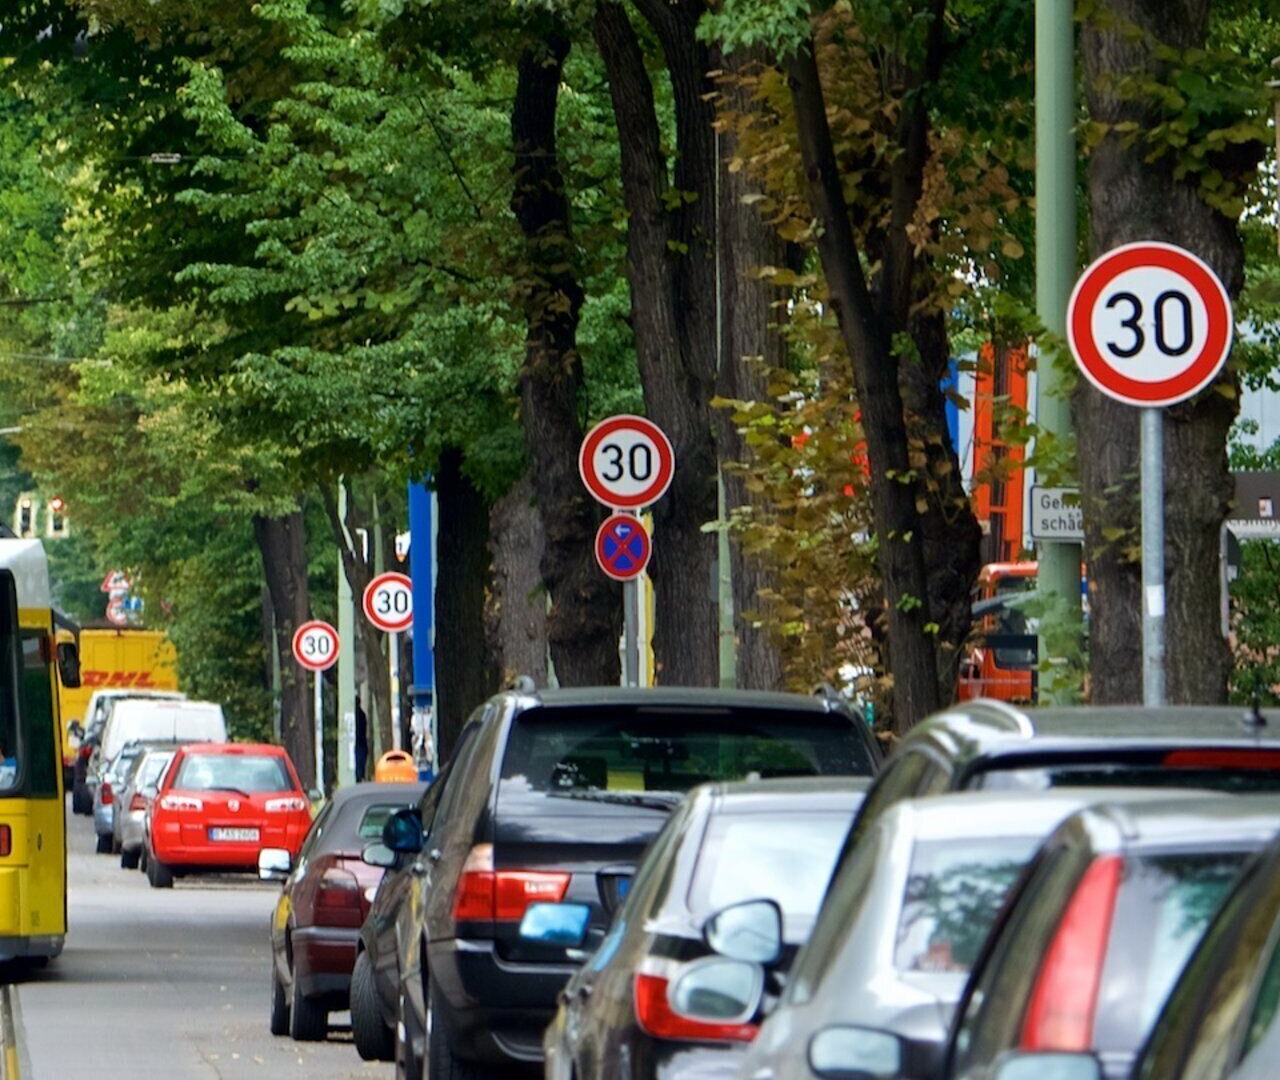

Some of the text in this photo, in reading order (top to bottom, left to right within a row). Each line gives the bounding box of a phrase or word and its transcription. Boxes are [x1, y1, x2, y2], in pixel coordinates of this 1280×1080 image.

[1105, 290, 1194, 358] 30
[602, 443, 652, 482] 30
[377, 589, 408, 614] 30
[305, 635, 330, 655] 30
[83, 671, 154, 687] DHL
